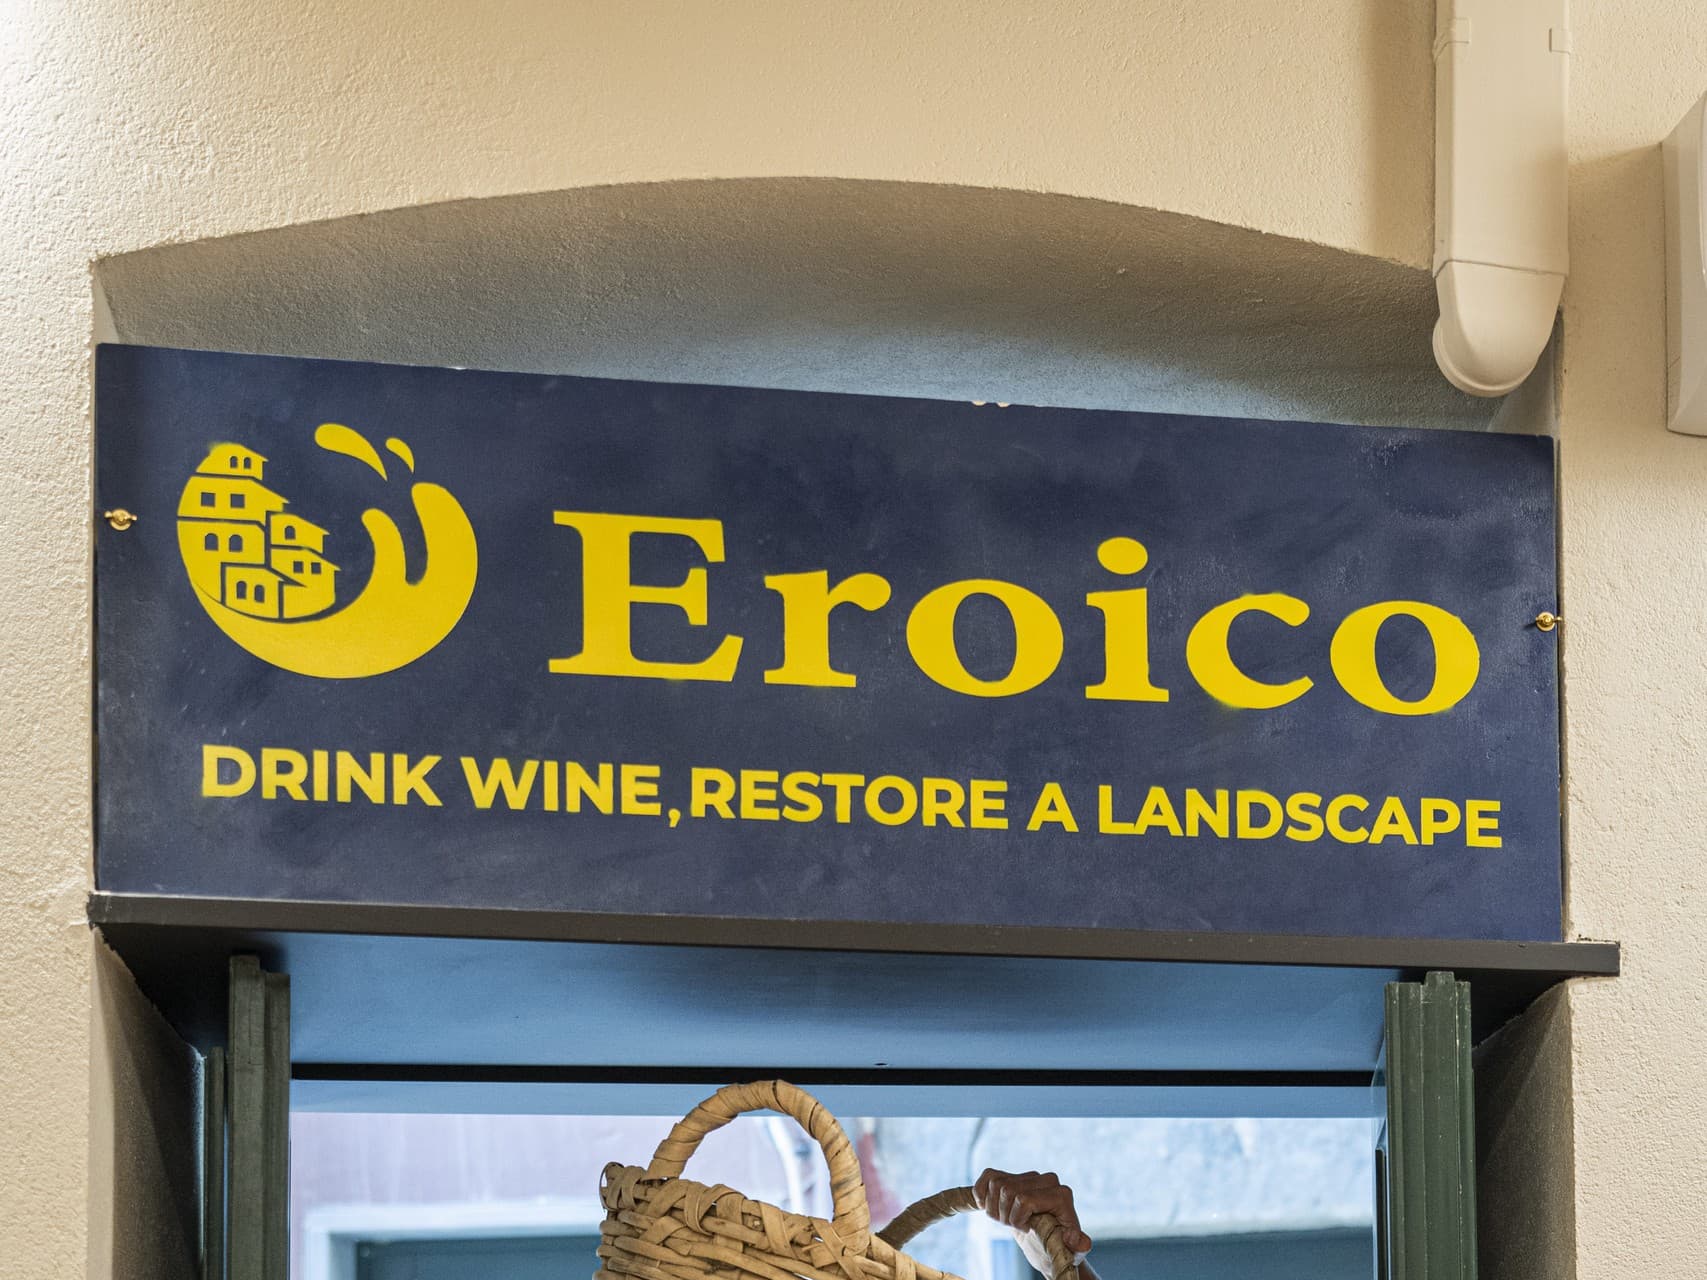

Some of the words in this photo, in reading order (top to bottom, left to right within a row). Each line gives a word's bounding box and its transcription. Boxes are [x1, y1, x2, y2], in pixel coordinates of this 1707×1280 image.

[549, 511, 1481, 715] Eroico
[200, 744, 443, 806] DRINK
[459, 756, 682, 828] WINE,
[689, 766, 1009, 830] RESTORE
[1026, 781, 1079, 832] A
[1098, 784, 1503, 849] LANDSCAPE
